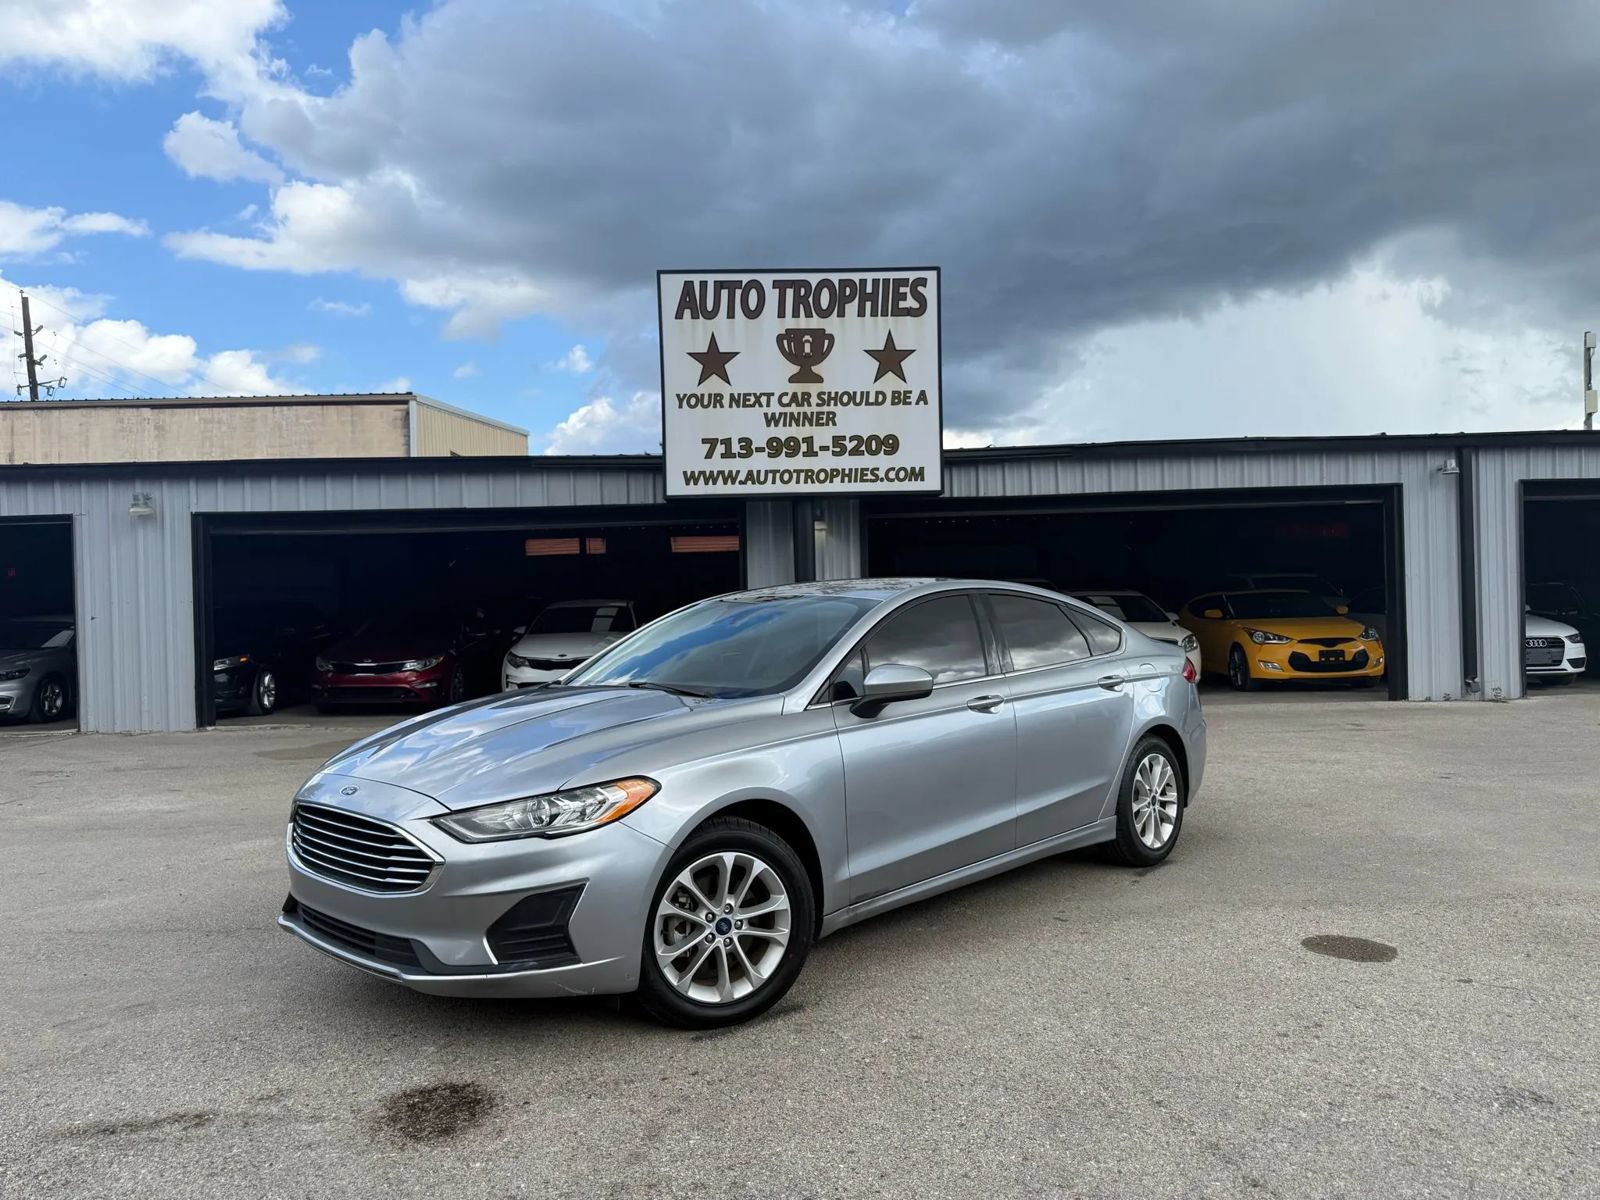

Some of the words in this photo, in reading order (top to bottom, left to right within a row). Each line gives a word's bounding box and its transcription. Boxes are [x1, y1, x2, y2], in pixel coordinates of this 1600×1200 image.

[675, 280, 766, 320] AUTO
[772, 277, 928, 319] TROPHIES
[676, 393, 725, 409] YOUR
[728, 392, 774, 408] NEXT
[778, 392, 813, 408] CAR
[816, 391, 887, 407] SHOULD
[891, 390, 912, 406] BE
[915, 390, 928, 405] A
[763, 411, 837, 428] WINNER
[701, 434, 900, 459] 713-991-5209
[682, 466, 925, 486] WWW.AUTOTROPHIES.COM
